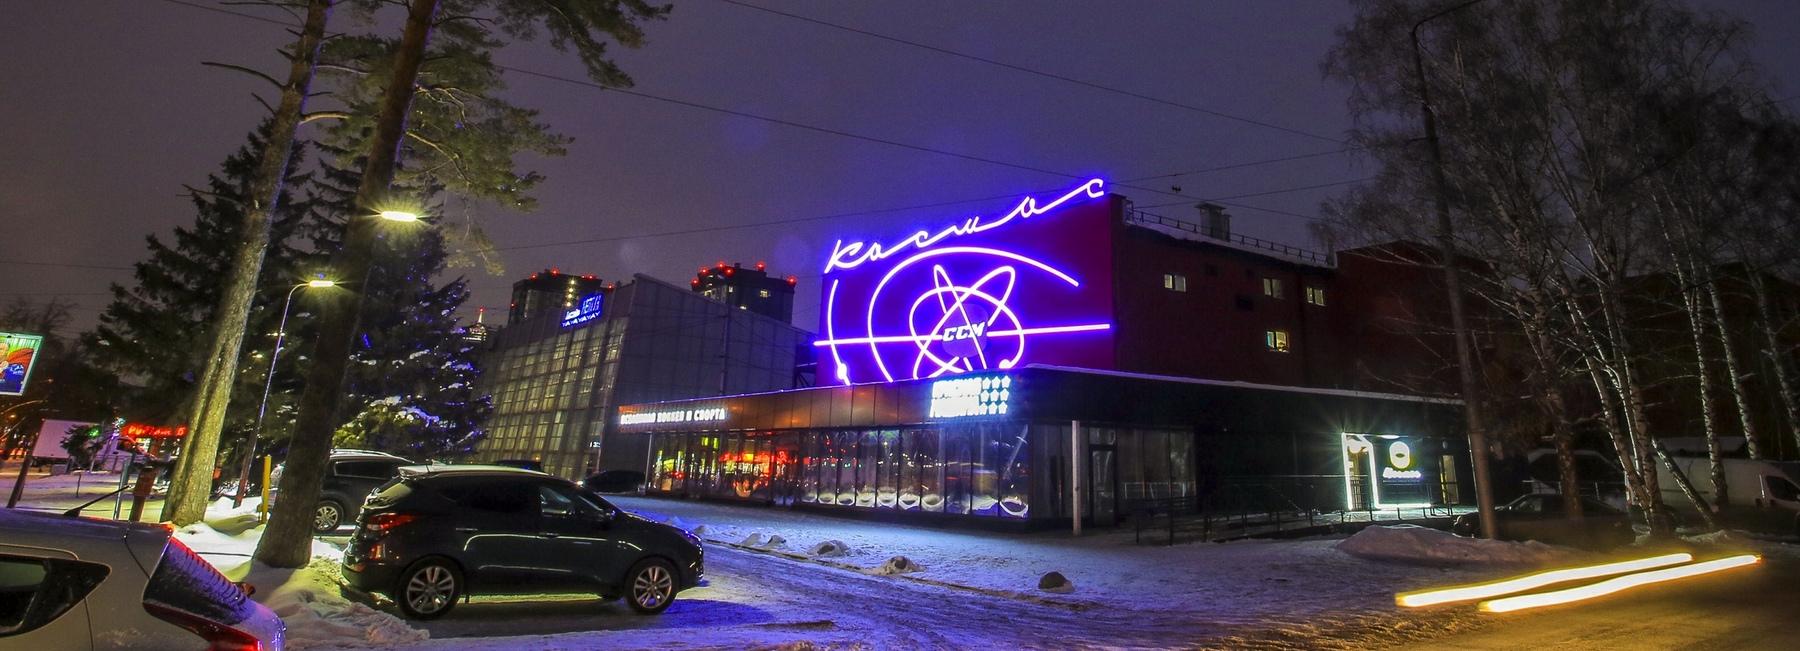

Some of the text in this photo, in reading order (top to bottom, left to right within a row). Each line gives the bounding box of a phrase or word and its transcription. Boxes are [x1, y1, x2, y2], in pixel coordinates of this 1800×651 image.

[823, 177, 1106, 274] Космос
[942, 321, 986, 342] CCM
[693, 408, 725, 421] СПОРТА
